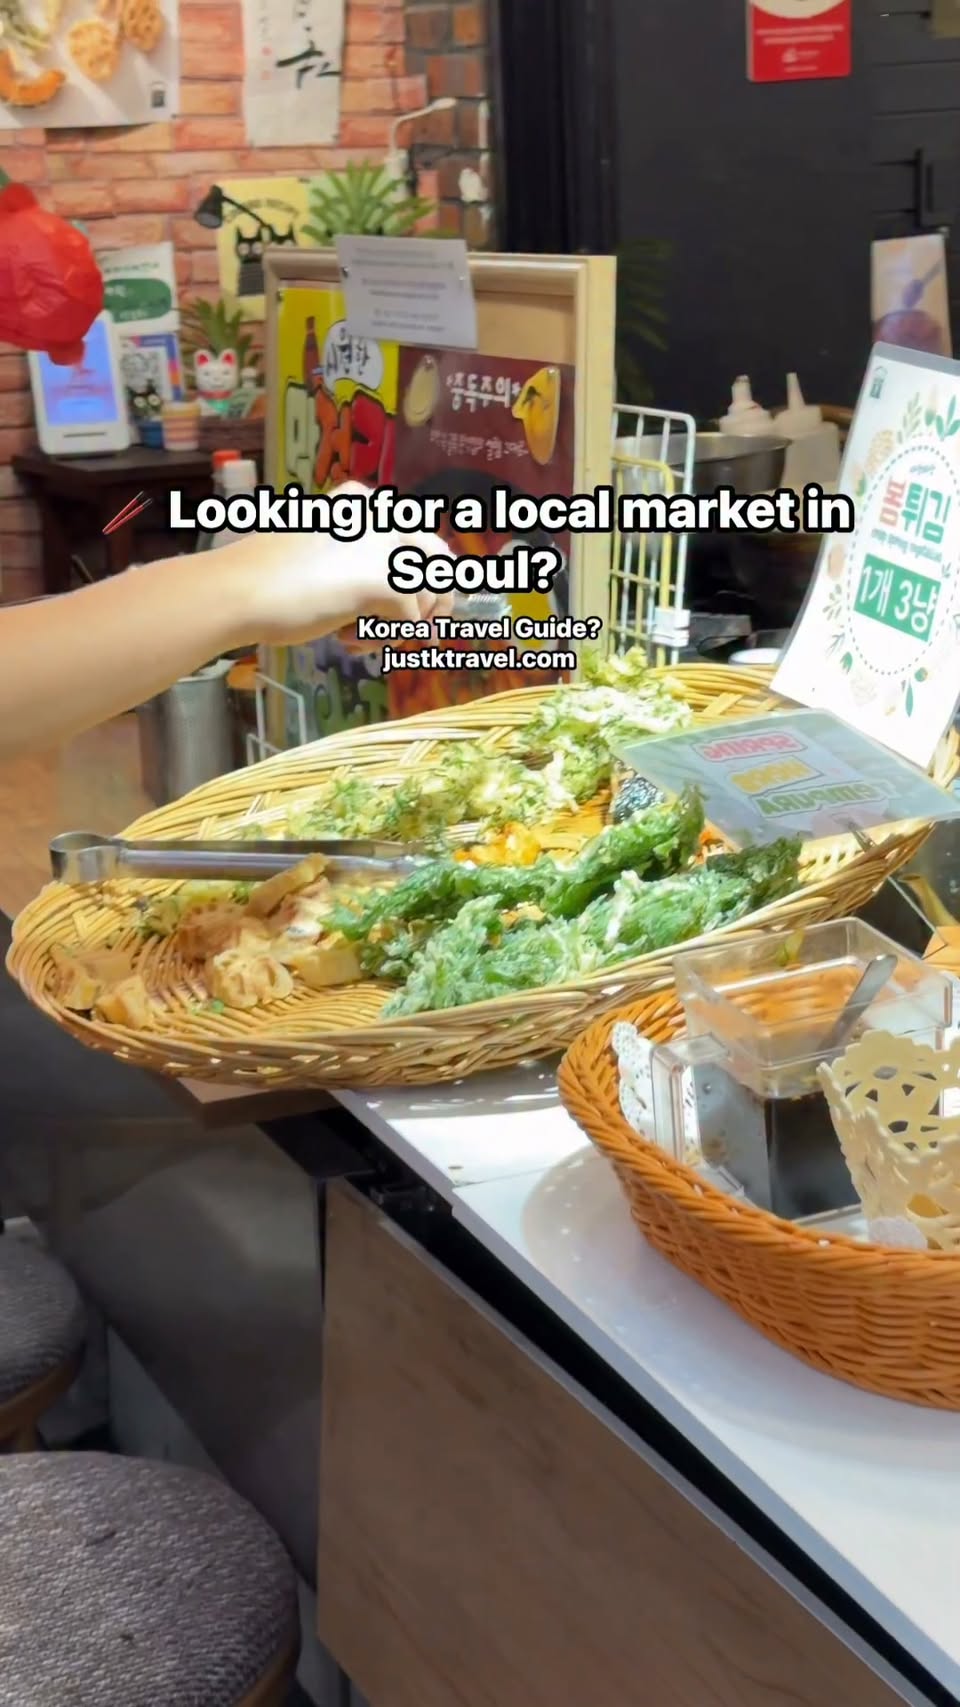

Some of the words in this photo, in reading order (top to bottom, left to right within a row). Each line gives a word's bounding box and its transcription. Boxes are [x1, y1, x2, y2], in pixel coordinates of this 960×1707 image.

[450, 372, 512, 412] 중독주의
[879, 477, 951, 544] 봄튀김
[860, 564, 895, 618] 1개
[893, 579, 938, 633] 3냥
